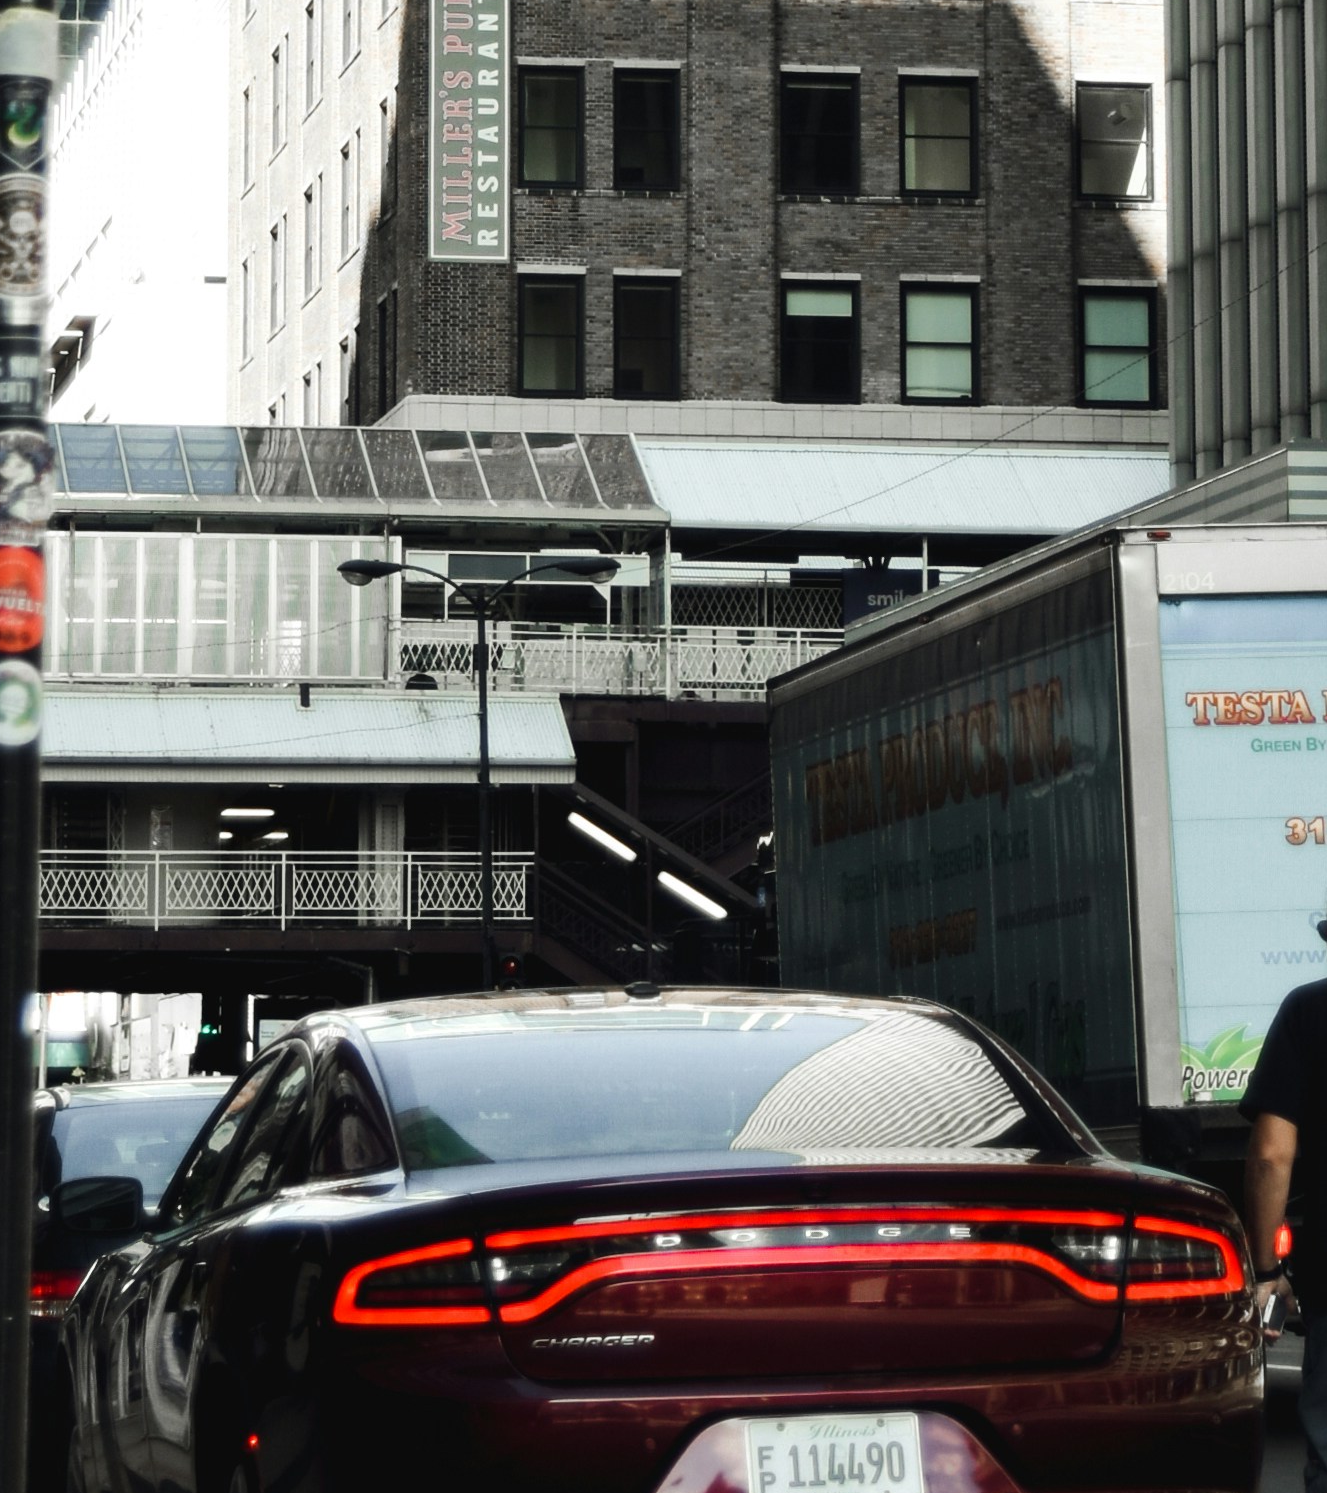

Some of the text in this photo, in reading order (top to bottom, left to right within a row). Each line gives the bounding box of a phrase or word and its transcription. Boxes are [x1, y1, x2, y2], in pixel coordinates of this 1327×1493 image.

[438, 70, 475, 245] MILLER'S
[1164, 570, 1215, 592] 2104
[1184, 689, 1316, 727] TESTA
[1250, 736, 1302, 754] GREEN
[1305, 736, 1327, 753] BY
[655, 1225, 972, 1248] DODGE
[530, 1333, 656, 1349] CHARGER
[808, 1422, 878, 1441] Illinois
[788, 1440, 906, 1489] 114490
